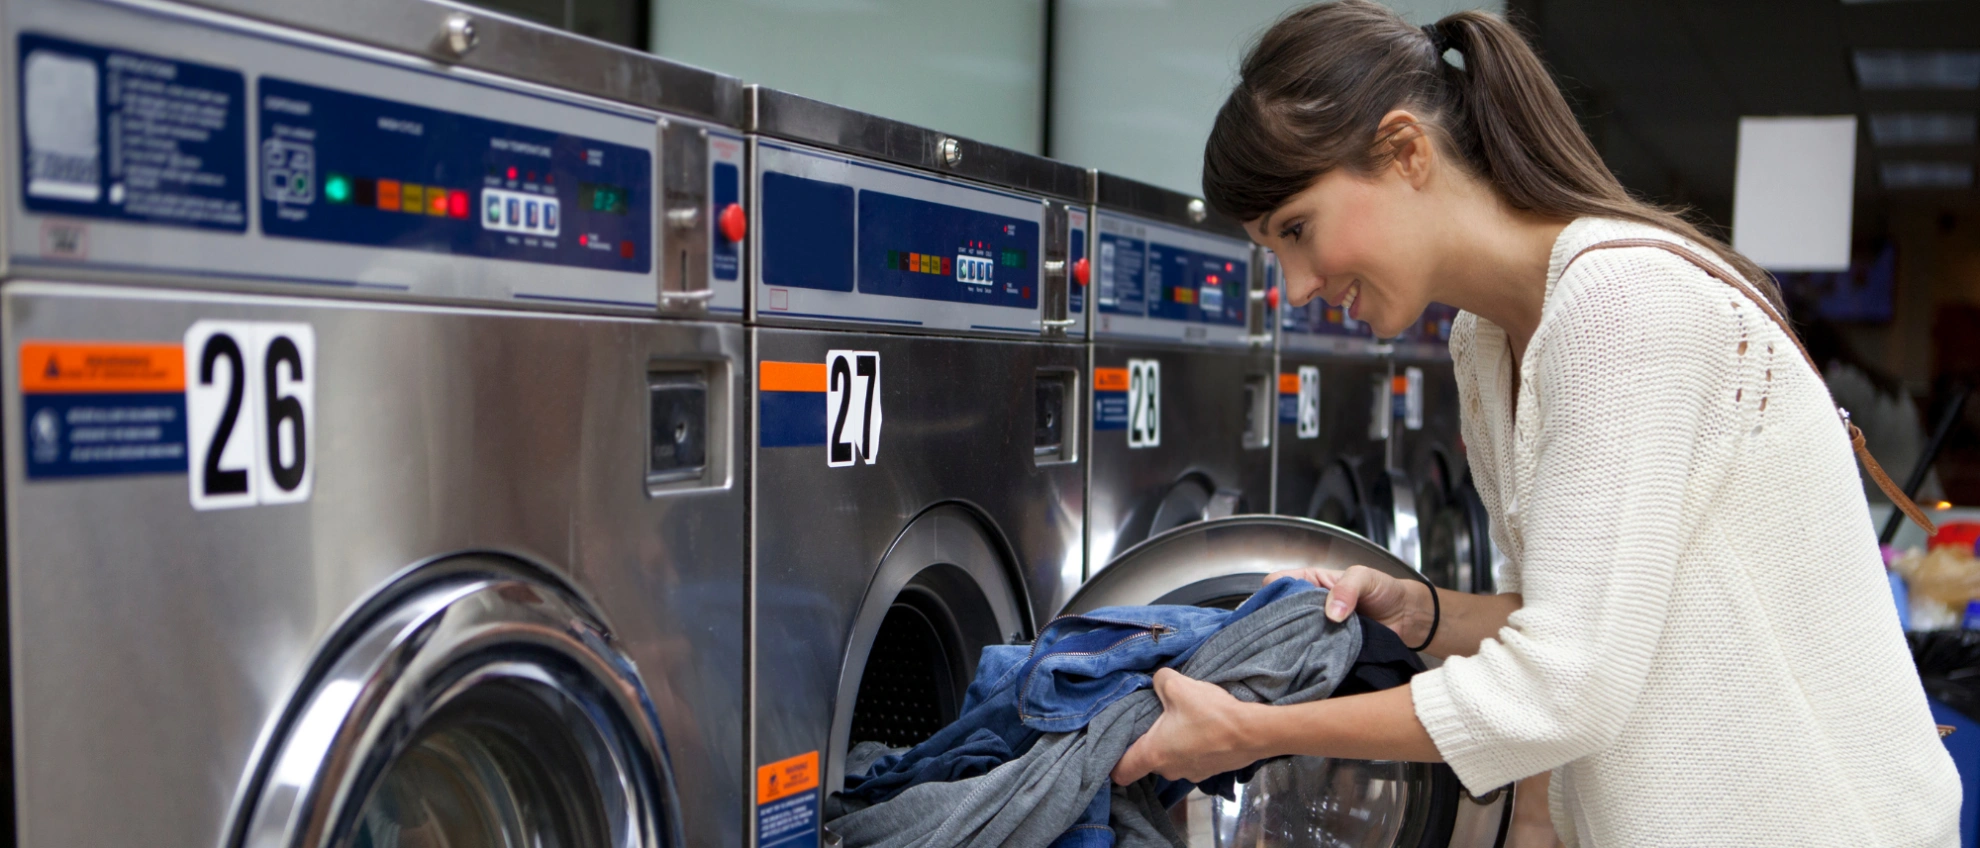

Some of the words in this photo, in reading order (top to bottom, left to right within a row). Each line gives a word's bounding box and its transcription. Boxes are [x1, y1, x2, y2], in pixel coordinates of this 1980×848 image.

[201, 333, 306, 494] 26
[830, 354, 877, 463] 27
[1131, 364, 1157, 442] 28
[1300, 373, 1317, 432] 29
